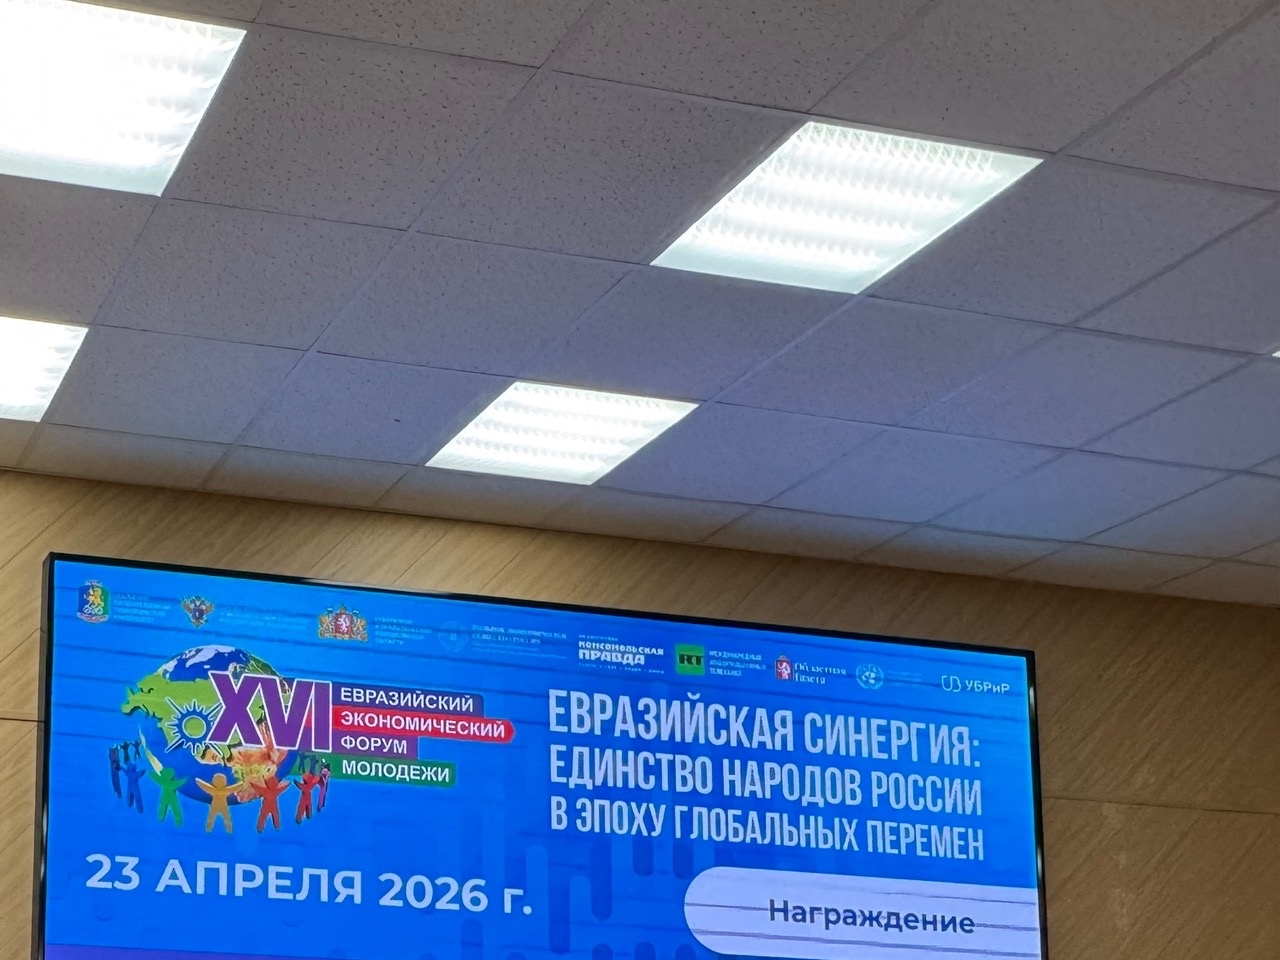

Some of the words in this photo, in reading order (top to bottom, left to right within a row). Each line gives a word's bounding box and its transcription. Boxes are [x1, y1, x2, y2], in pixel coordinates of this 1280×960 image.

[579, 649, 645, 666] ПРАВДА
[678, 653, 702, 666] RT
[340, 685, 474, 713] ЕВРАЗИЙСКИЙ
[966, 680, 1010, 693] УБРиР
[206, 670, 332, 753] XVI
[340, 711, 505, 738] ЭКОНОМИЧЕСКИЙ
[548, 688, 793, 751] ЕВРАЗИЙСКАЯ
[803, 712, 981, 768] СИНЕРГИЯ:
[340, 737, 407, 755] ФОРУМ
[341, 761, 450, 783] МОЛОДЕЖИ
[549, 744, 713, 794] ЕДИНСТВО
[722, 758, 862, 807] НАРОДОВ
[871, 771, 982, 816] РОССИИ
[550, 796, 567, 830] В
[575, 798, 667, 837] ЭПОХУ
[674, 806, 859, 852] ГЛОБАЛЬНЫХ
[867, 820, 984, 861] ПЕРЕМЕН
[85, 854, 140, 893] 23
[152, 860, 361, 906] АПРЕЛЯ
[377, 871, 489, 913] 2026
[500, 888, 533, 917] г.
[767, 895, 977, 936] Награждение
